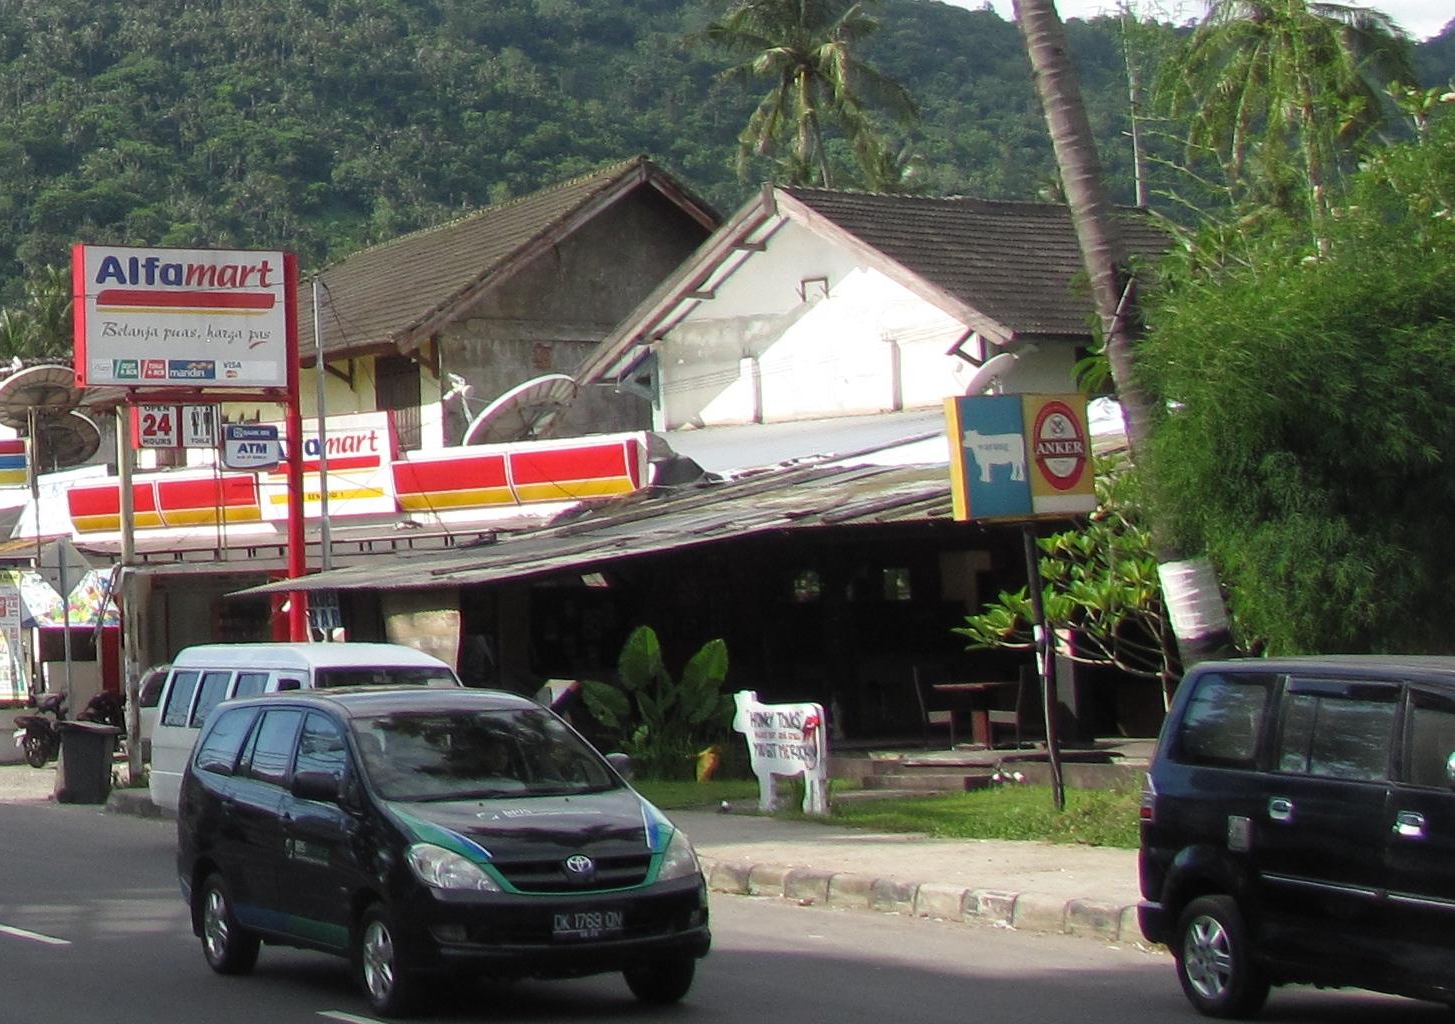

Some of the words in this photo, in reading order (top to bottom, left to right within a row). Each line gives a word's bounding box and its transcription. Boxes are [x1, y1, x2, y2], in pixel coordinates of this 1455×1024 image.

[95, 255, 274, 288] Alfamart
[102, 321, 158, 341] Belanja
[206, 325, 243, 344] harga
[248, 329, 271, 341] pas
[143, 414, 173, 436] 24
[143, 437, 172, 445] HOURS
[237, 443, 267, 454] ATM
[1036, 441, 1084, 455] ANKER
[554, 914, 571, 929] DK
